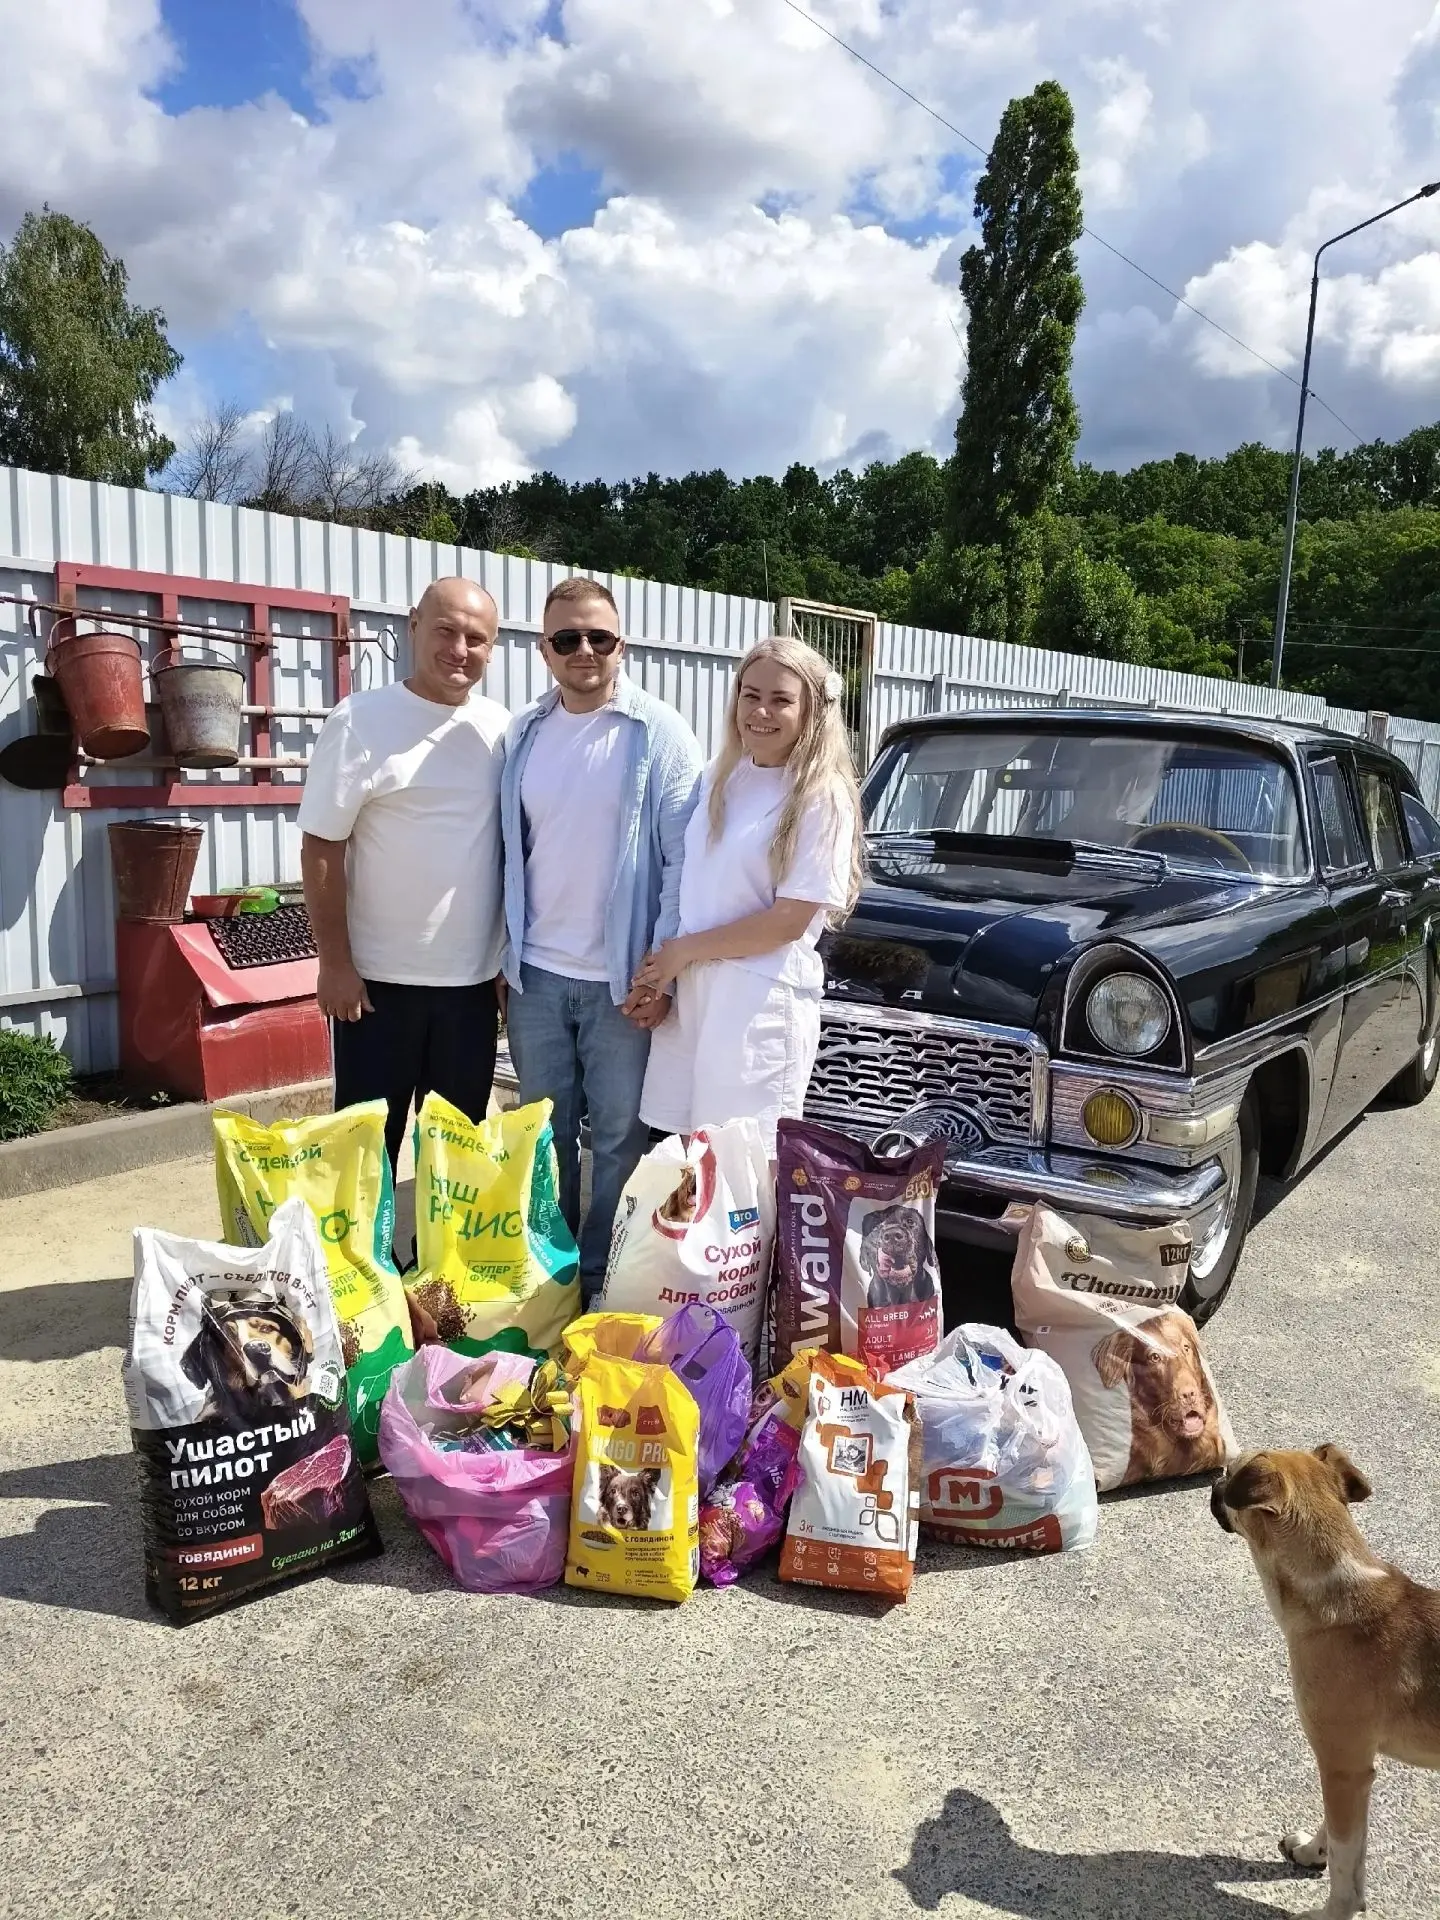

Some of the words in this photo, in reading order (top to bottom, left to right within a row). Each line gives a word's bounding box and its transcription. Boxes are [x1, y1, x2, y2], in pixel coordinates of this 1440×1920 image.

[252, 1143, 322, 1172] дейой
[440, 1130, 510, 1162] индеой
[430, 1195, 522, 1241] РЦИО
[733, 1211, 753, 1223] aro
[380, 1209, 391, 1267] индейкой
[705, 1235, 761, 1265] Сухой
[332, 1270, 358, 1287] УПЕР
[470, 1274, 497, 1283] ФУД
[471, 1265, 511, 1274] СУПЕР
[718, 1260, 760, 1283] корм
[333, 1283, 358, 1297] ФУД
[658, 1286, 700, 1304] для
[706, 1280, 757, 1304] собак
[1060, 1271, 1181, 1304] Chammy
[163, 1303, 181, 1346] КОРМ
[175, 1273, 205, 1302] ПИОТ
[224, 1270, 291, 1284] СЪЕДТСЯ
[864, 1314, 881, 1323] ALL
[883, 1311, 909, 1321] BREED
[865, 1335, 892, 1344] ADULT
[892, 1351, 916, 1361] LAMB
[165, 1406, 317, 1464] Ушастый
[170, 1451, 273, 1490] пилот
[174, 1492, 214, 1511] сухой
[216, 1485, 251, 1505] корм
[948, 1480, 980, 1504] М
[175, 1511, 200, 1524] для
[202, 1504, 244, 1520] собак
[177, 1526, 193, 1538] со
[195, 1518, 246, 1537] вкусом
[630, 1534, 674, 1543] говядиной
[178, 1542, 256, 1565] говядины
[271, 1546, 318, 1571] Сделано
[319, 1539, 335, 1552] на
[178, 1576, 199, 1591] 12
[202, 1575, 223, 1590] кг
